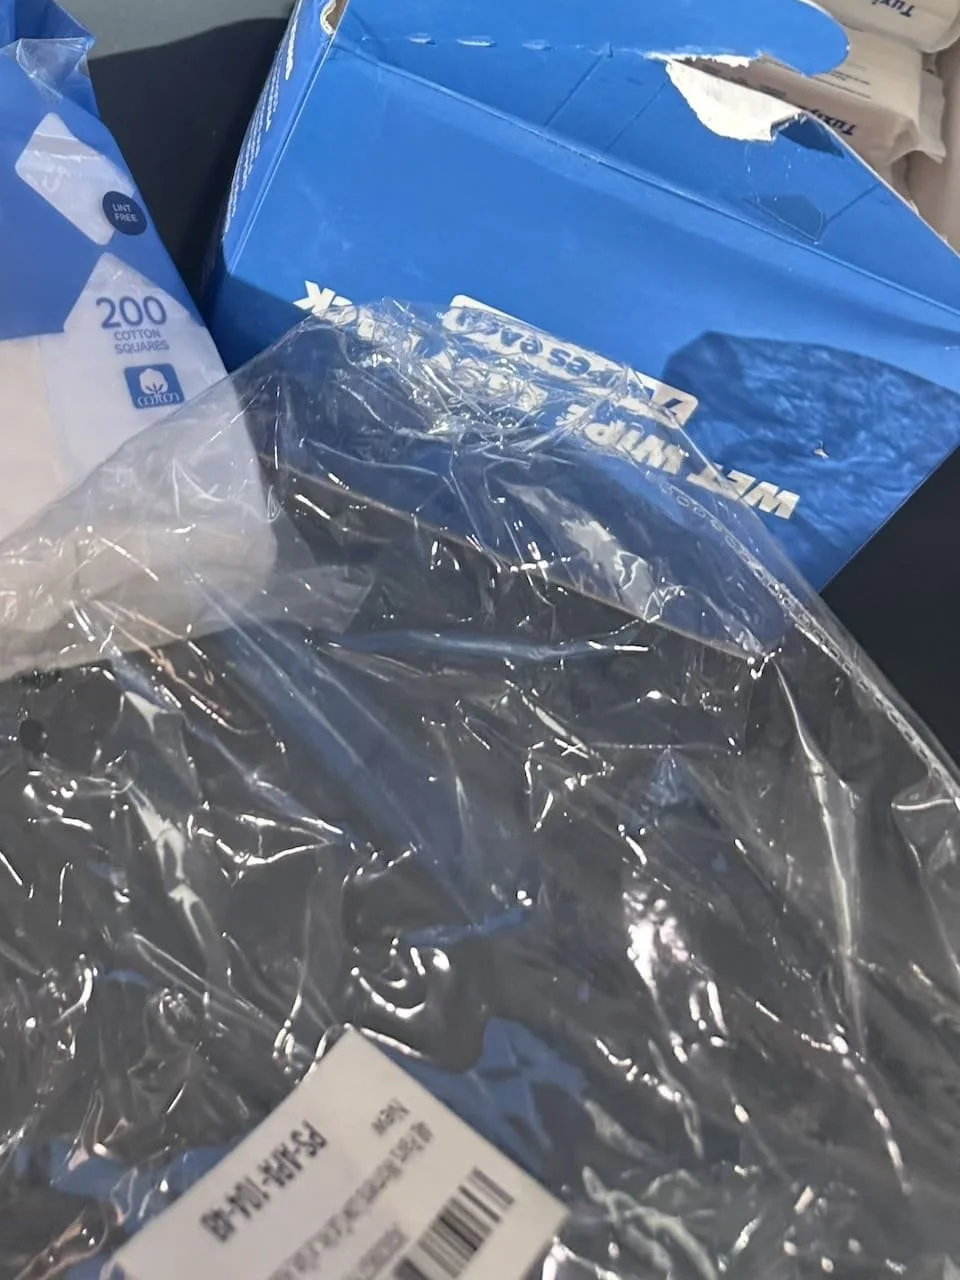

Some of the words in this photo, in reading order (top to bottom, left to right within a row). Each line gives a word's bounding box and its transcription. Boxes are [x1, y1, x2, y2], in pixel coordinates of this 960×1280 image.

[112, 203, 132, 213] LINT
[114, 213, 138, 223] FREE
[96, 296, 168, 329] 200
[113, 328, 162, 342] COTTON
[114, 340, 171, 355] SQUARES
[687, 463, 800, 520] WET
